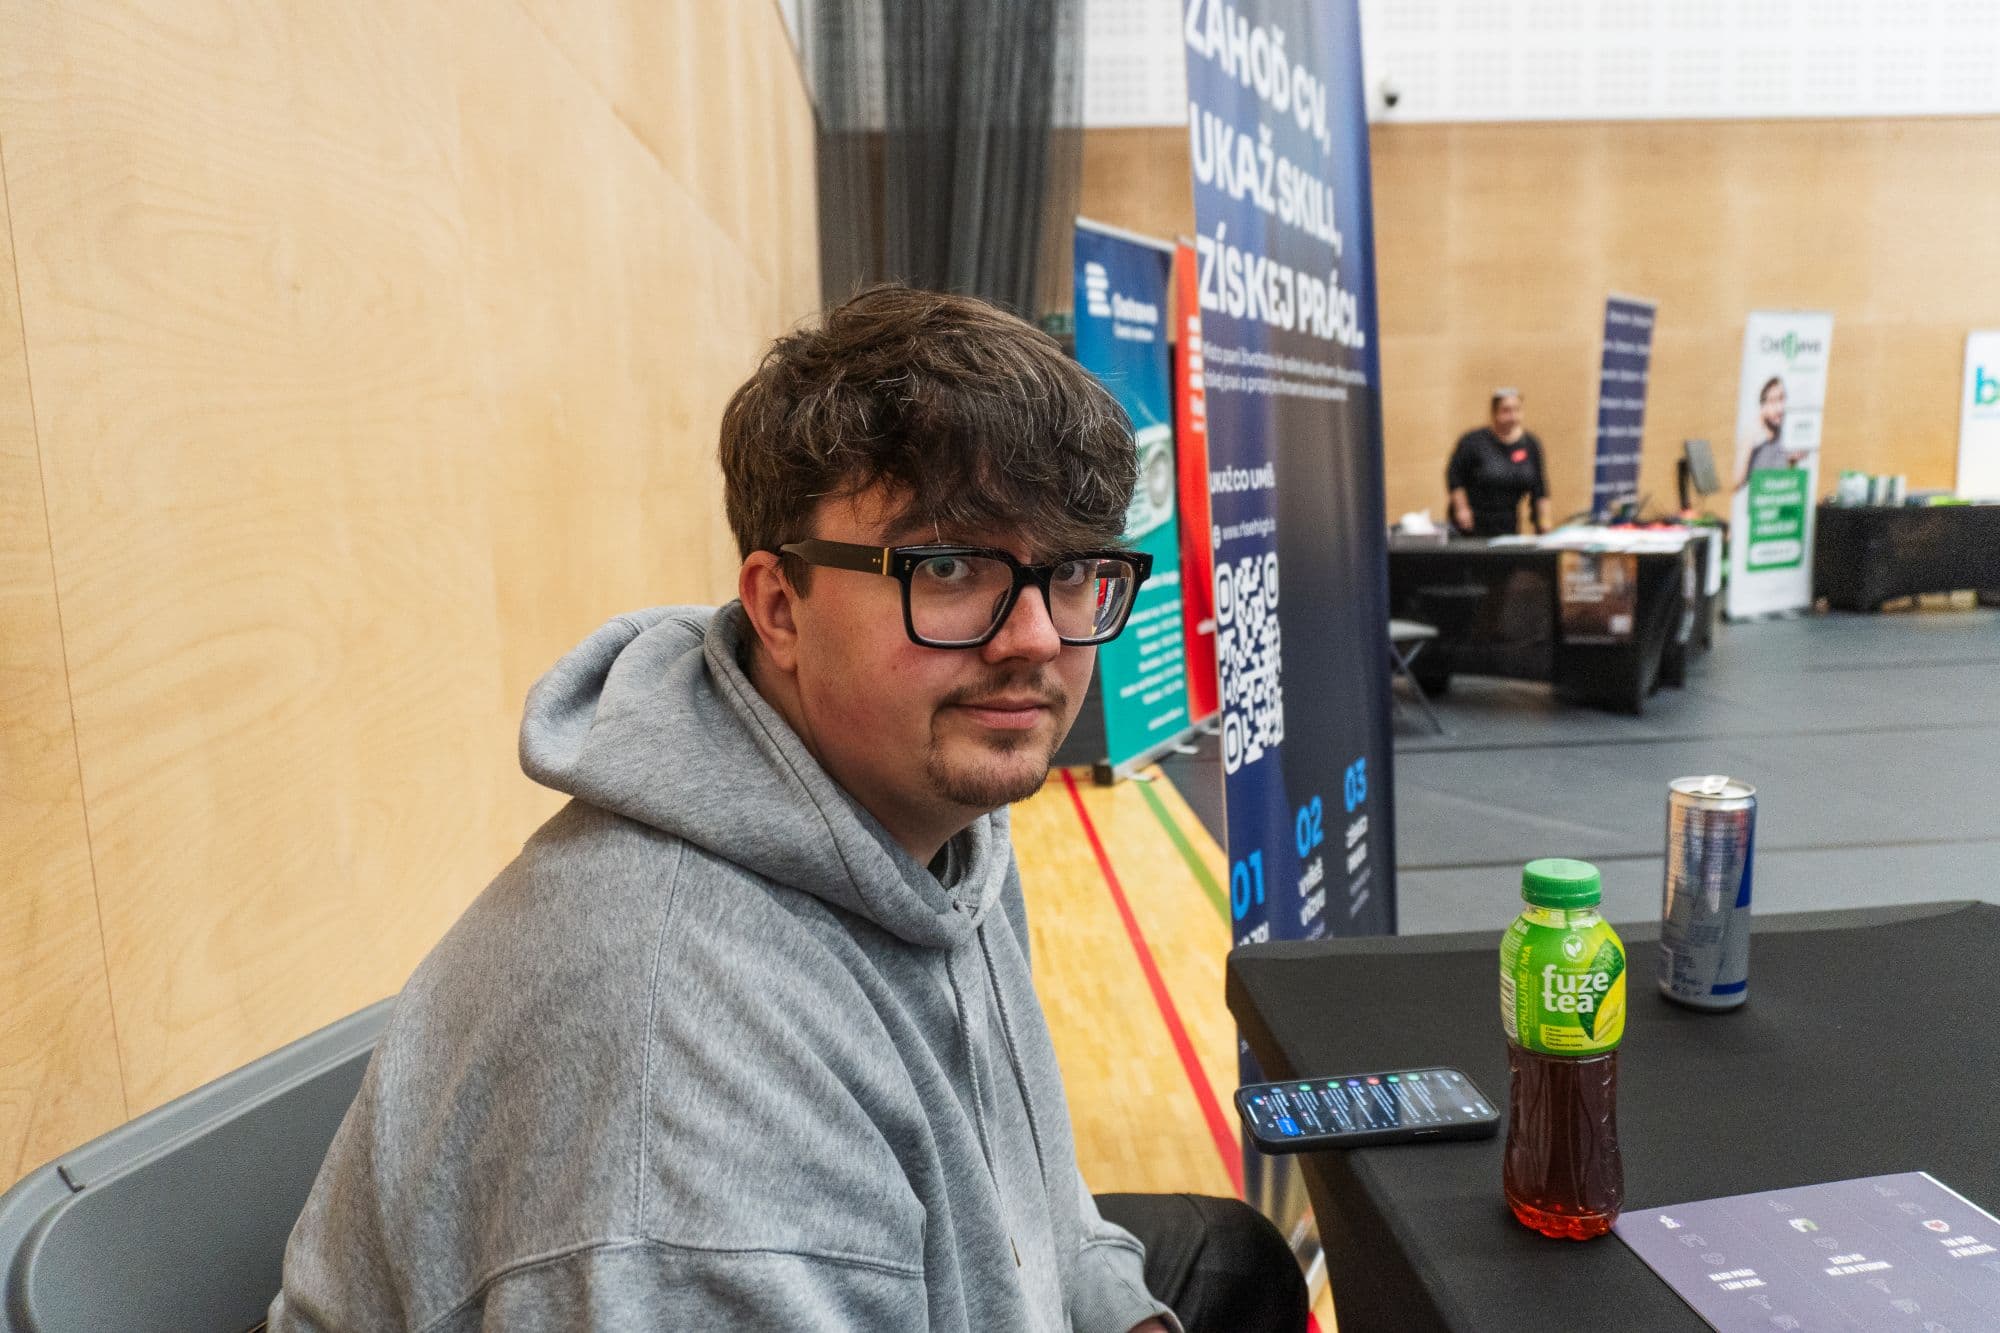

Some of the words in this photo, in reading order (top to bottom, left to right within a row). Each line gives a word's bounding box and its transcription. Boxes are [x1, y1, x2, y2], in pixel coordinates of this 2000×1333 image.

[1186, 0, 1290, 112] ZAHOĎ
[1293, 64, 1331, 155] CV,
[1190, 102, 1276, 213] UKAŽ
[1277, 156, 1342, 255] SKILL,
[1197, 222, 1295, 330] ZÍSKEJ
[1297, 269, 1365, 348] PRÁCI.
[1233, 469, 1249, 491] CO
[1344, 757, 1366, 811] 03
[1296, 795, 1323, 857] 02
[1231, 849, 1264, 920] 01
[1541, 964, 1609, 993] fuze
[1541, 991, 1594, 1013] tea
